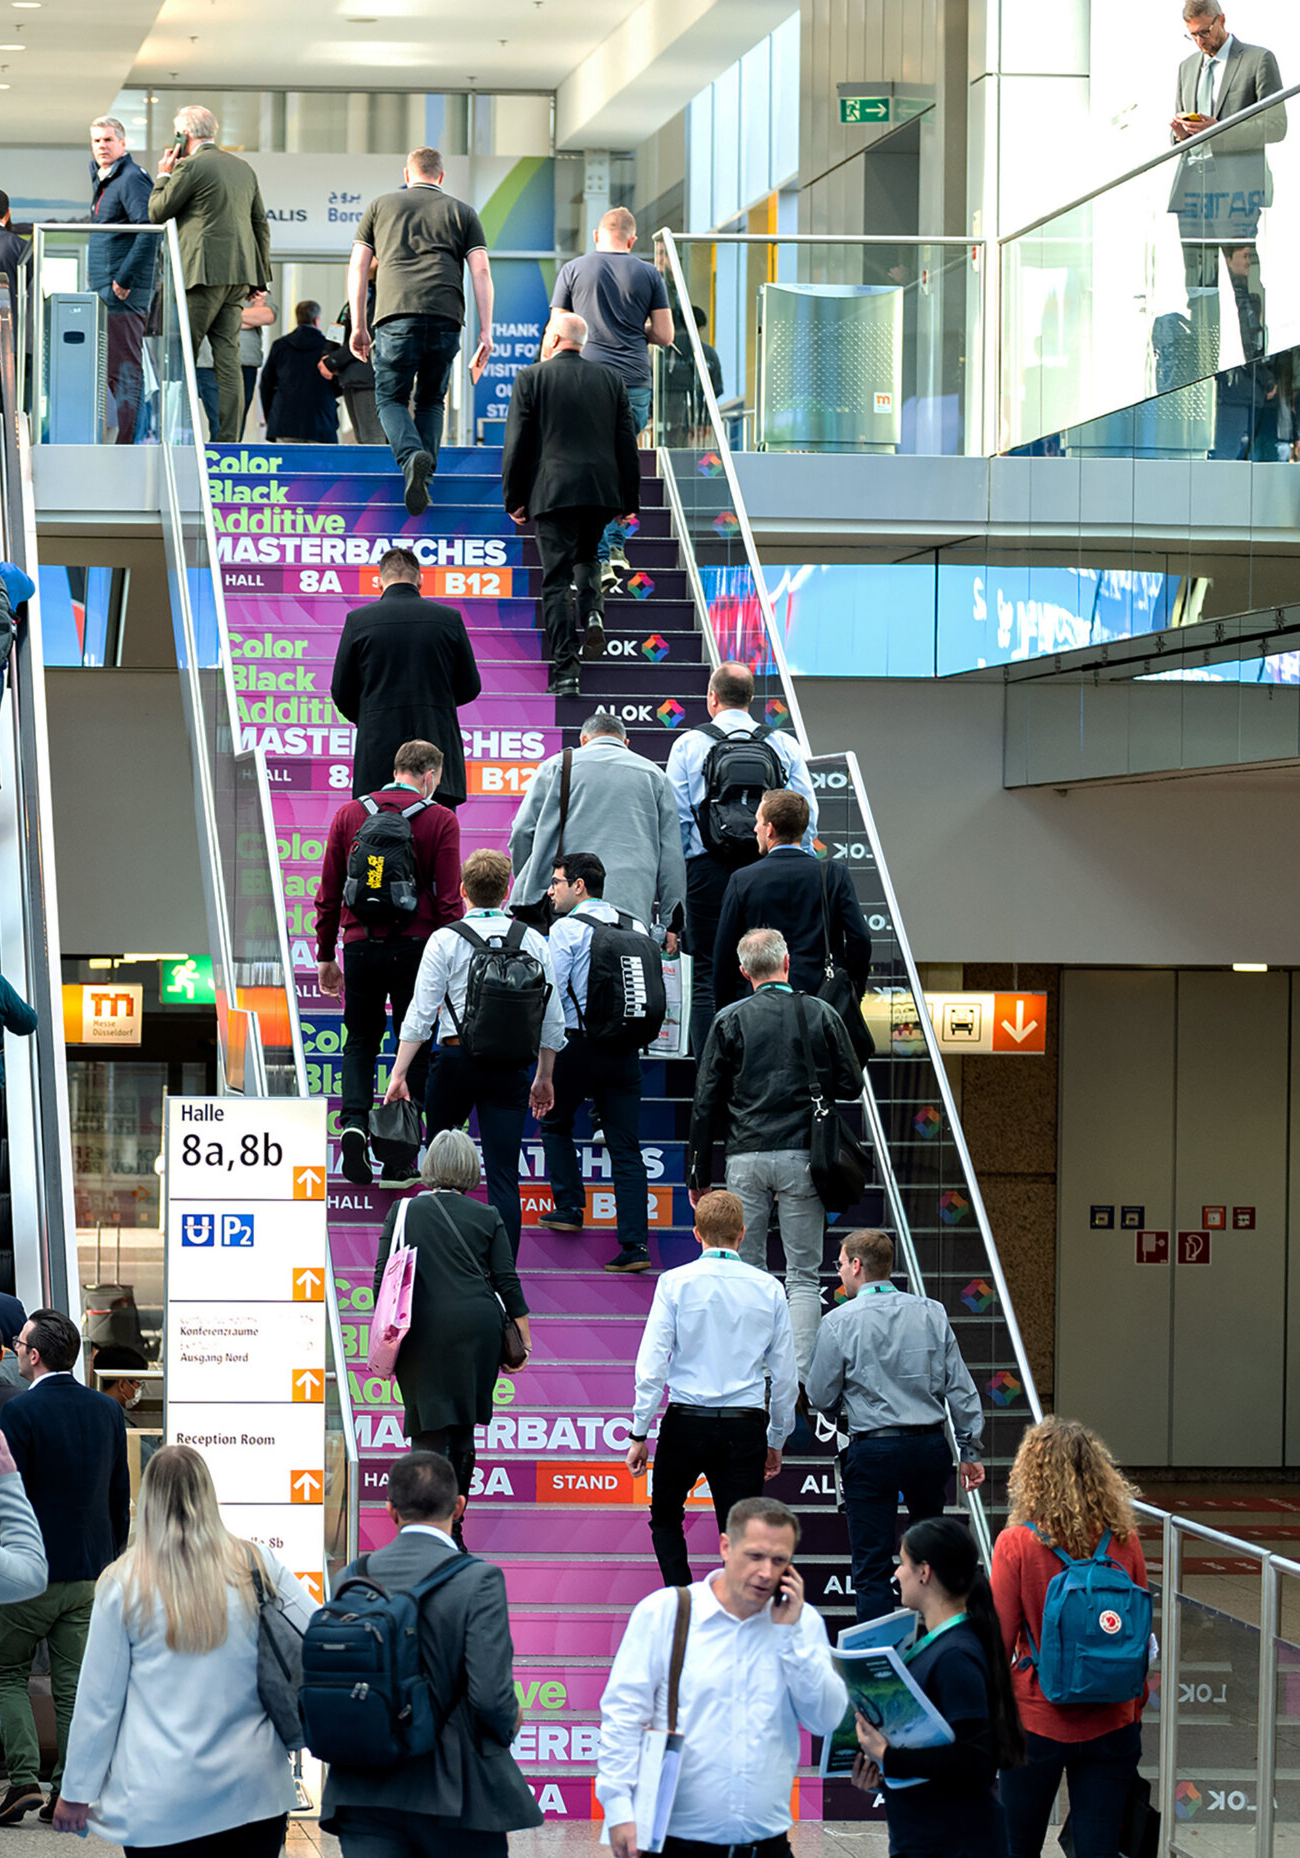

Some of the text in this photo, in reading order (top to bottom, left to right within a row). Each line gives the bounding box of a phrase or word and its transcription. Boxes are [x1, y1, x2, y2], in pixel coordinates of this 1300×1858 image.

[490, 344, 541, 357] OU FO
[207, 450, 283, 473] Color
[210, 479, 289, 504] Black
[212, 507, 346, 534] Additive
[225, 574, 265, 587] HALL
[299, 570, 343, 593] 8A
[445, 572, 501, 596] B12
[228, 632, 308, 659] Color
[232, 664, 316, 691] Black
[481, 767, 538, 791] B12
[181, 1103, 225, 1121] Halle
[182, 1132, 283, 1171] 8a,8b
[327, 1195, 373, 1210] HALL
[180, 1352, 249, 1365] Ausgang Nord
[176, 1433, 276, 1447] Reception Room
[552, 1475, 618, 1490] STAND
